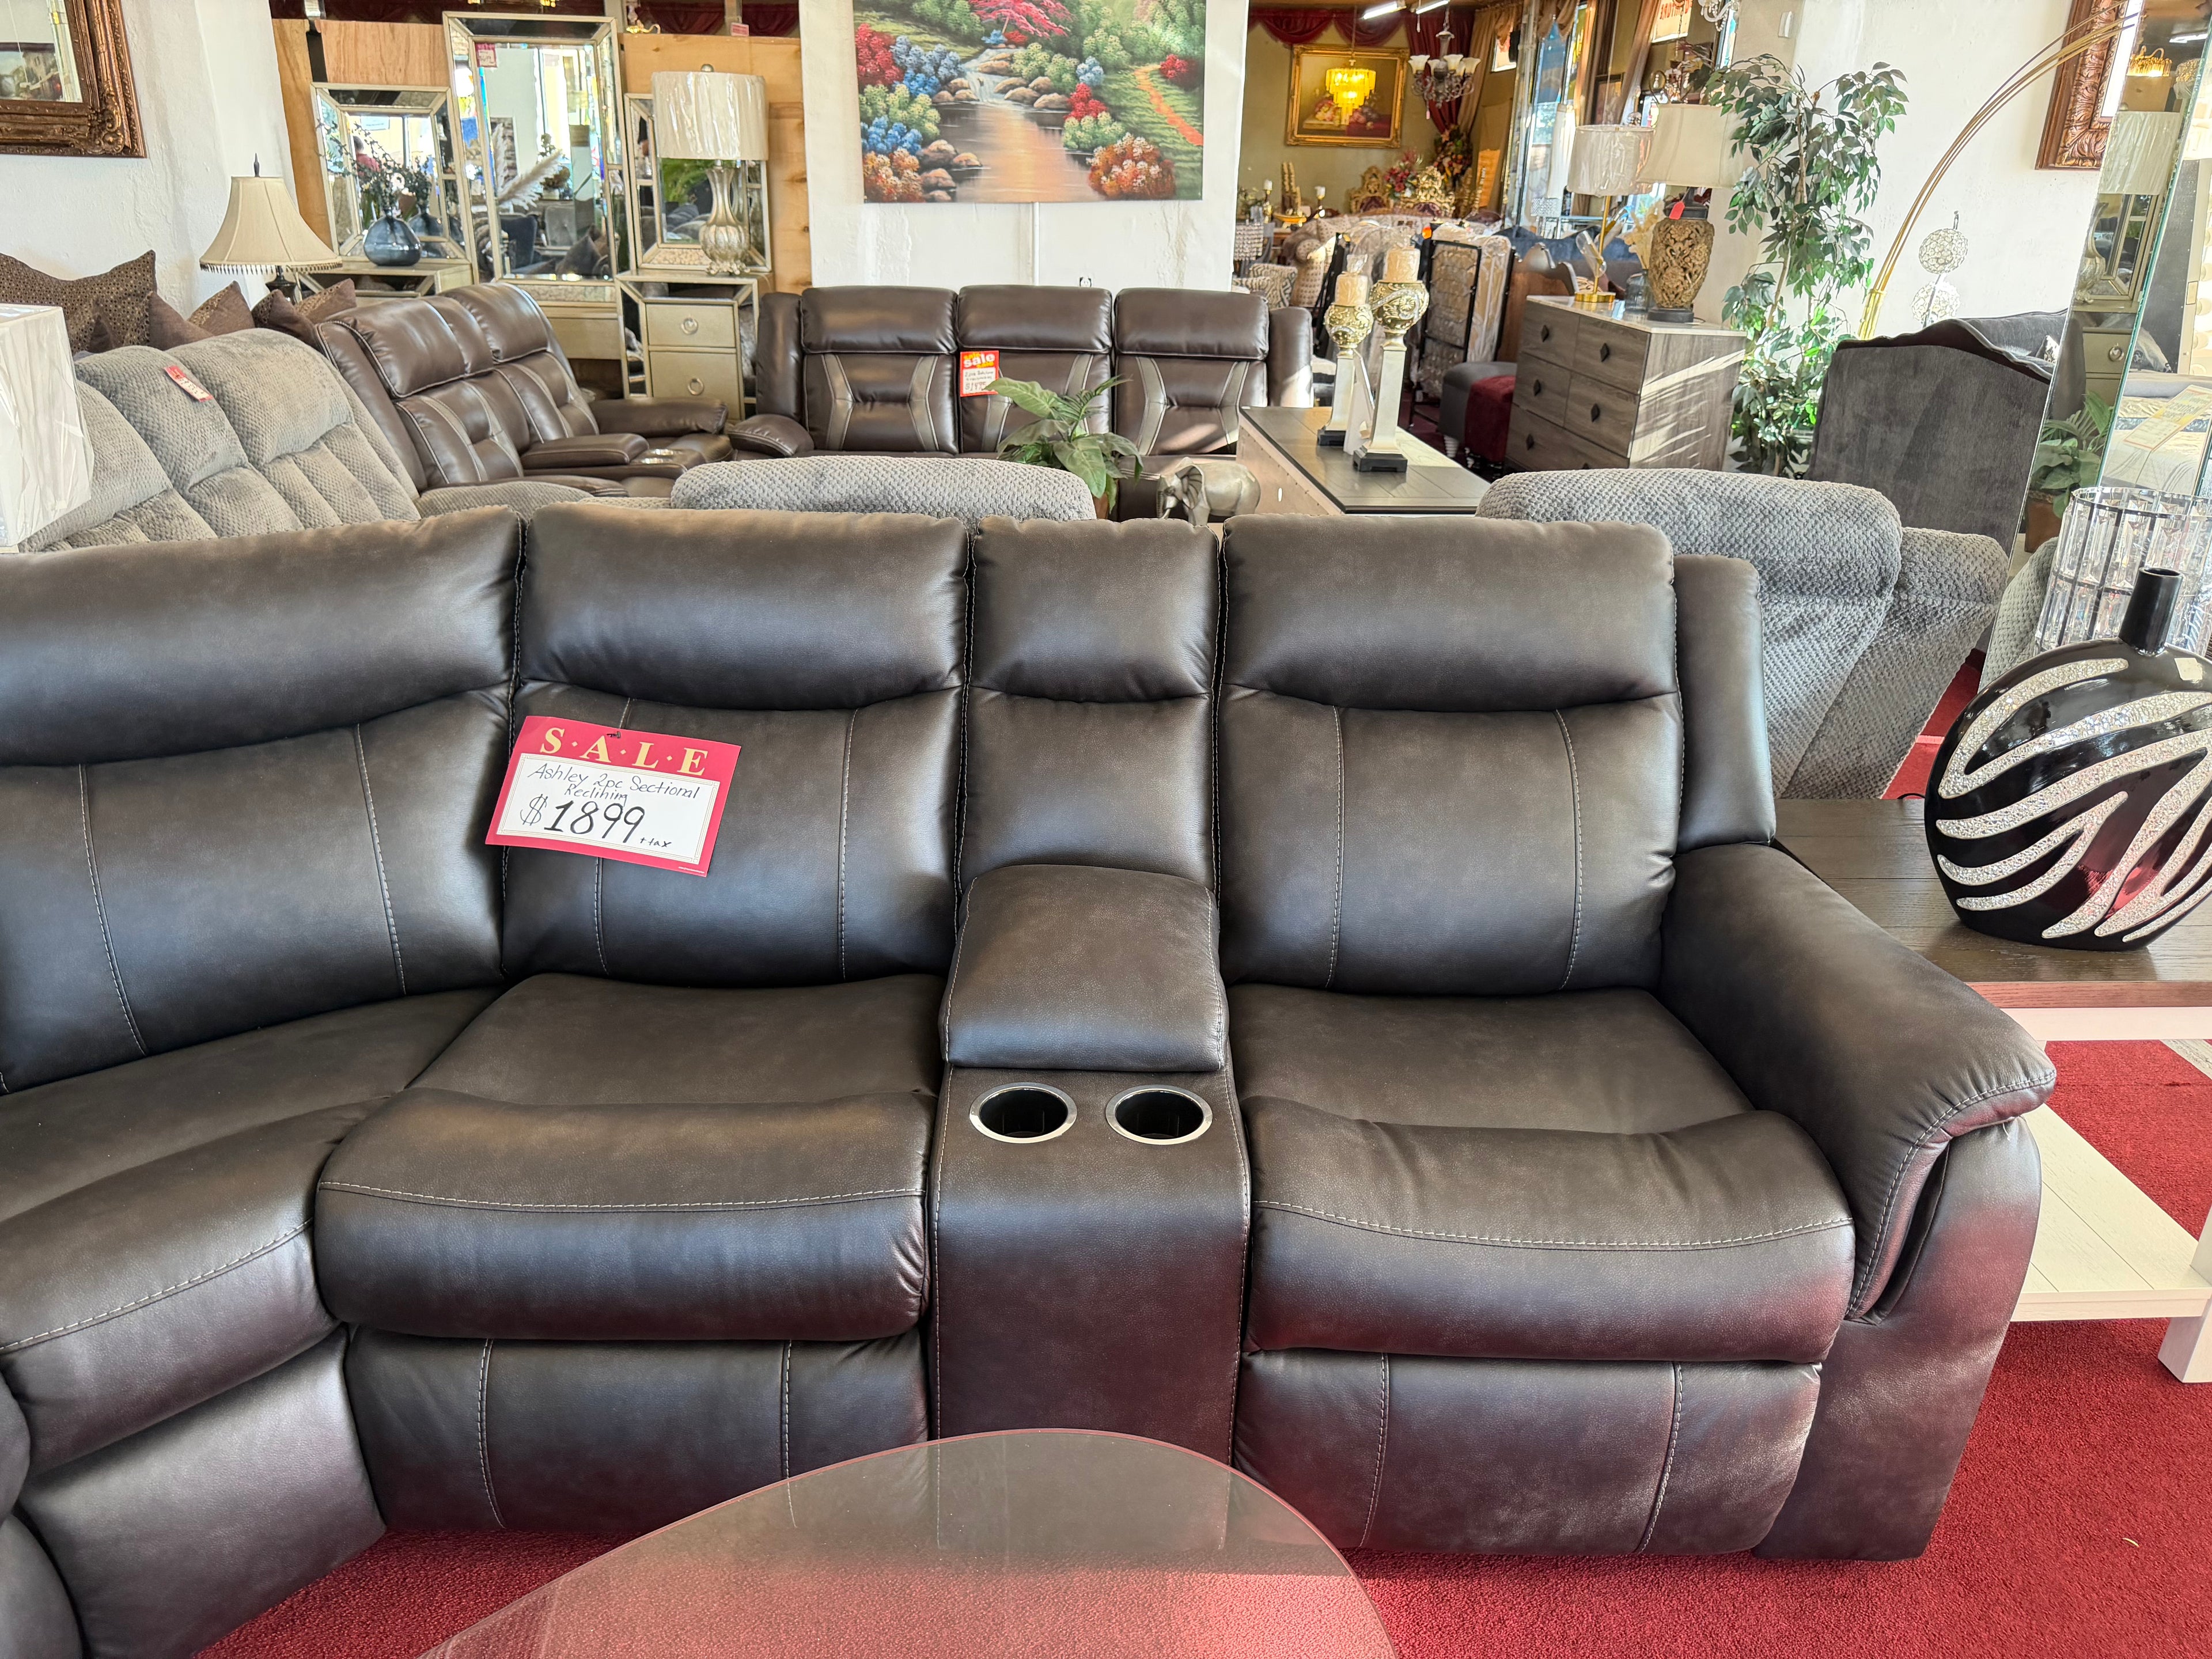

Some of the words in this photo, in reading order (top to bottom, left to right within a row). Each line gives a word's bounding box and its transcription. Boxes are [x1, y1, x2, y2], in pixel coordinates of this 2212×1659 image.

[964, 353, 995, 368] sale
[528, 763, 589, 786] Ashley
[593, 773, 623, 789] 2pc
[630, 775, 700, 799] Sectional
